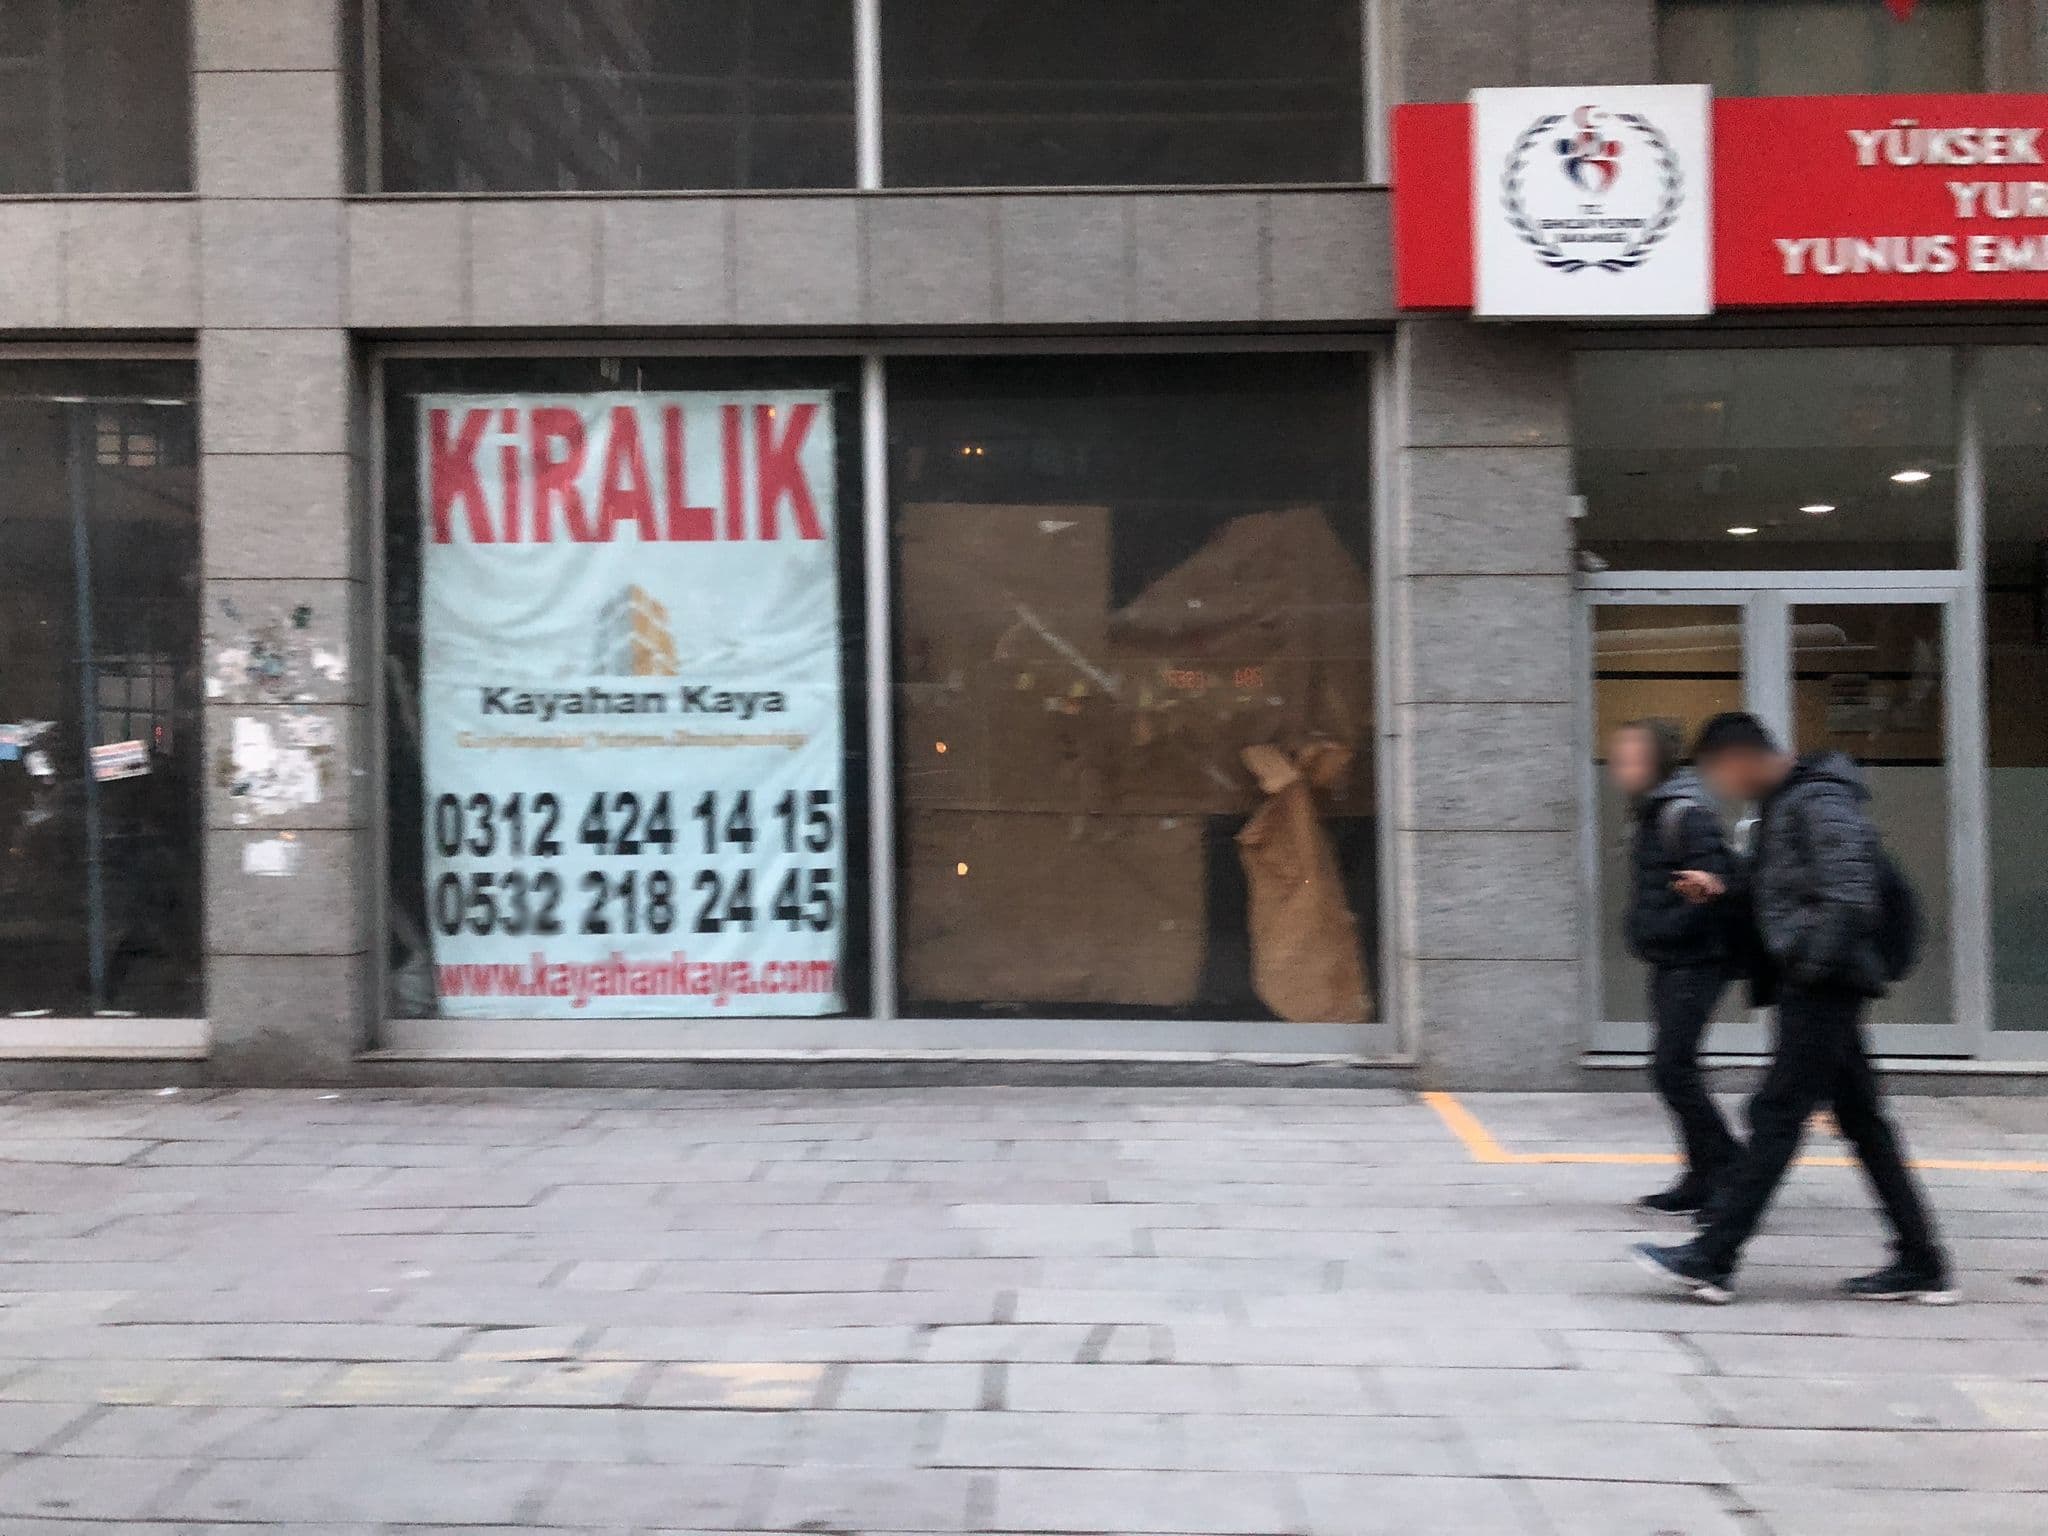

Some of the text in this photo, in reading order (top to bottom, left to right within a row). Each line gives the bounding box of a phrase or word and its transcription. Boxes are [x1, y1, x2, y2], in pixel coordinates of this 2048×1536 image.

[1847, 118, 2045, 166] YÜKSEK
[1774, 235, 1958, 274] YUNUS
[481, 685, 789, 721] Kayahan Kaya
[435, 789, 833, 857] 0312 424 14 15
[435, 868, 834, 936] 0532 218 24 45
[436, 950, 834, 1008] www.kayahankaya.com
